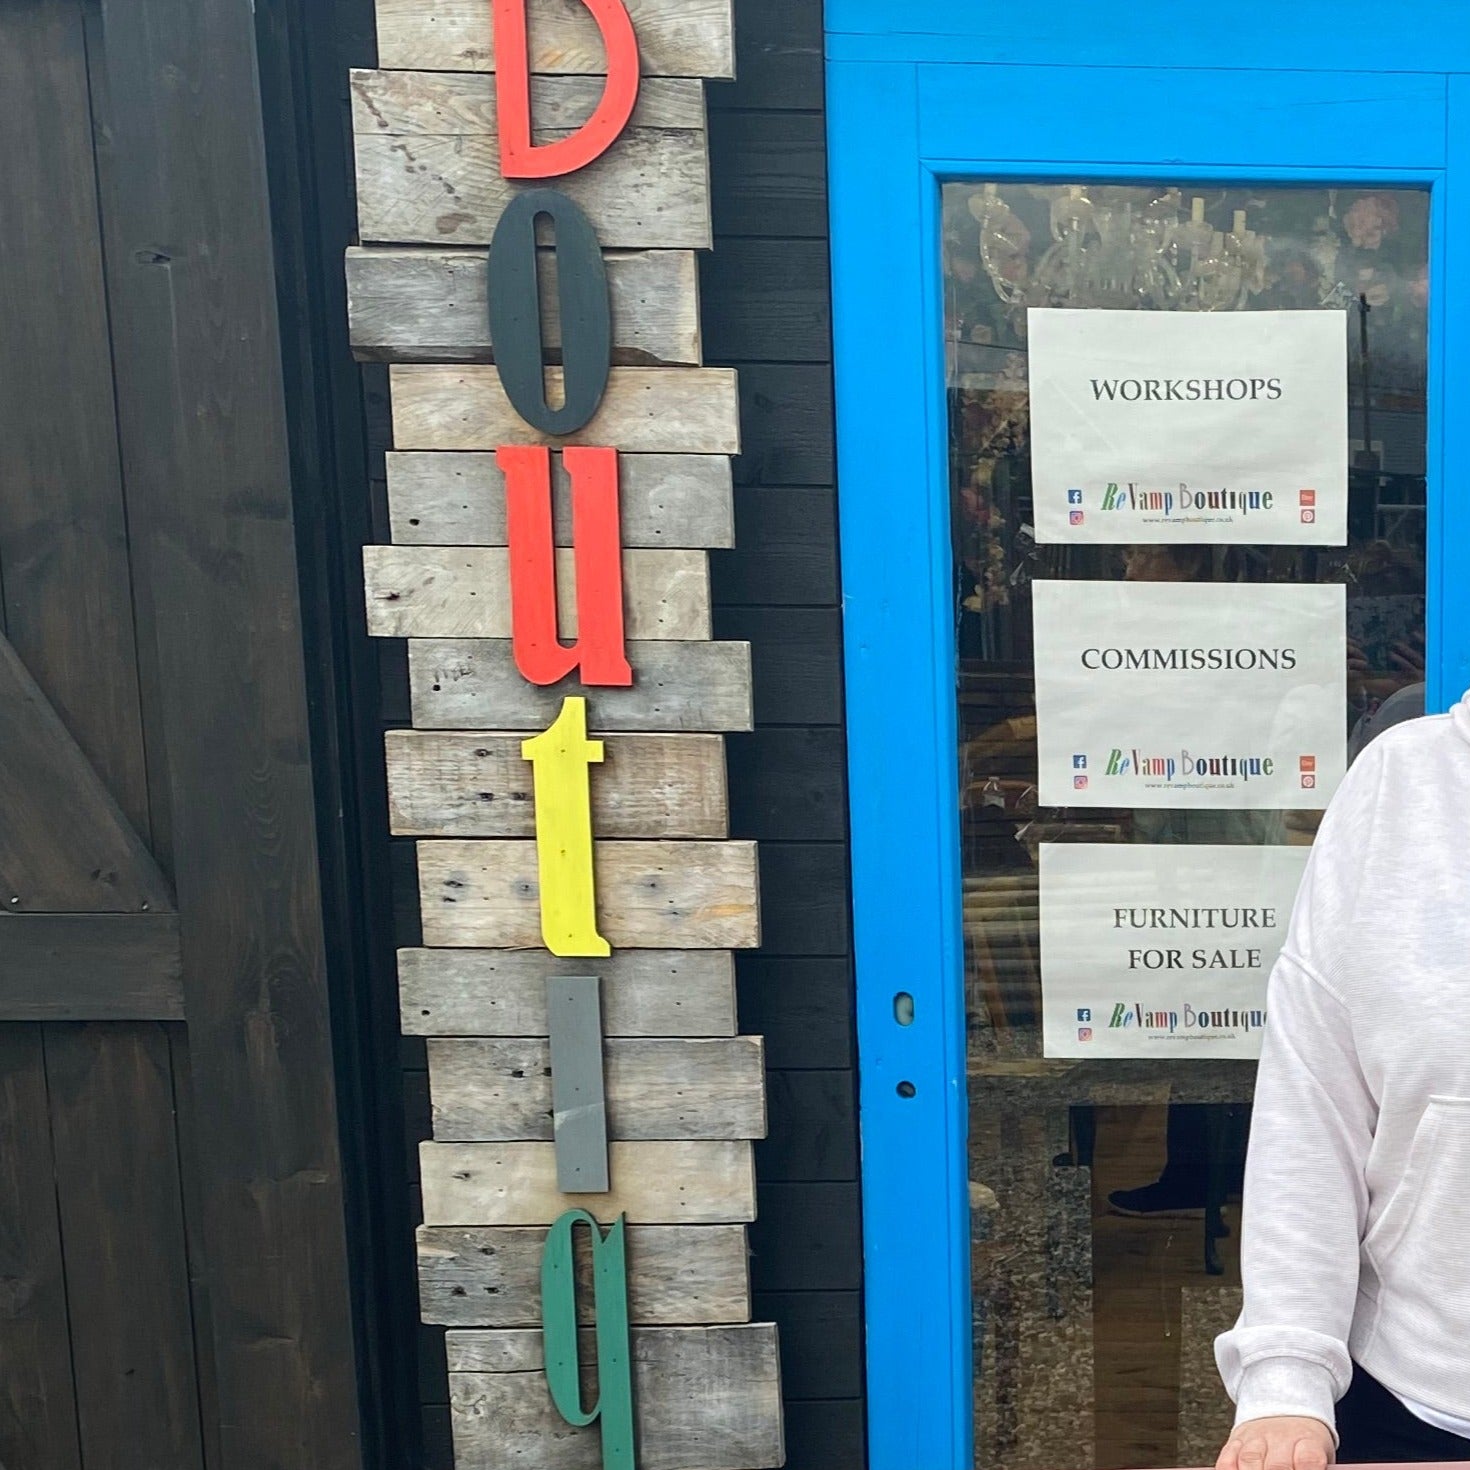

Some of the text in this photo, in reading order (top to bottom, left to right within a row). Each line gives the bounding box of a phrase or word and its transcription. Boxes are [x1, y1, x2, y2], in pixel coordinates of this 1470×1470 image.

[1090, 378, 1282, 401] WORKSHOPS
[1101, 482, 1274, 515] ReVamp Boutique
[1081, 648, 1297, 670] COMMISSIONS
[1105, 749, 1274, 782] ReVamp Boutique
[1113, 908, 1277, 929] FURNITURE
[1128, 949, 1262, 970] FOR SALE
[1108, 1002, 1178, 1034] ReVamp
